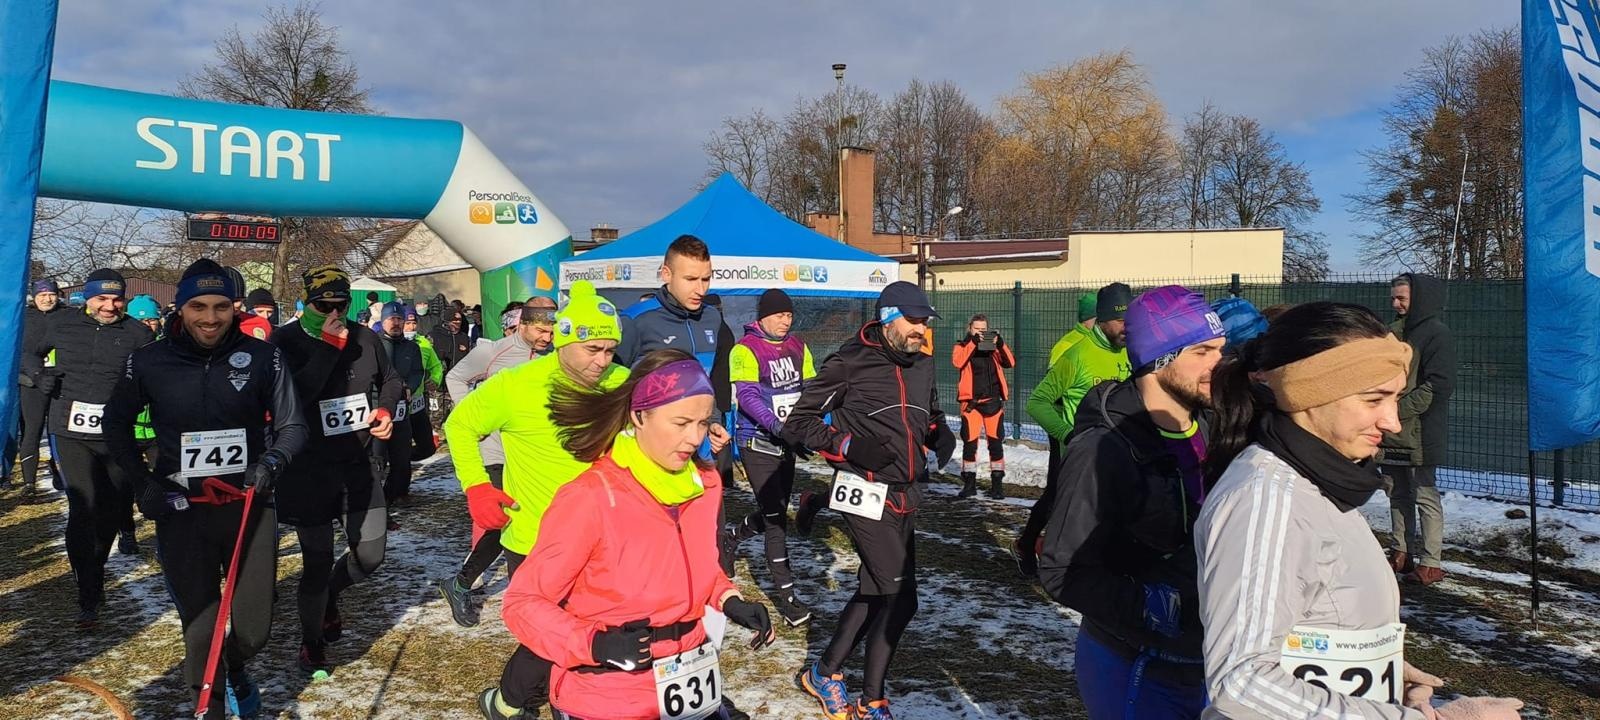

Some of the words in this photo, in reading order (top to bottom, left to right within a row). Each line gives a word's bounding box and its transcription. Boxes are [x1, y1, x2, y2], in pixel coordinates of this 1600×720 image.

[136, 117, 342, 182] START
[469, 190, 533, 203] PersonalBest
[211, 224, 276, 239] 0:00:09
[711, 265, 779, 280] rsonalBest
[73, 413, 101, 428] 69
[325, 406, 366, 428] 627
[185, 445, 243, 468] 742
[664, 669, 716, 717] 631
